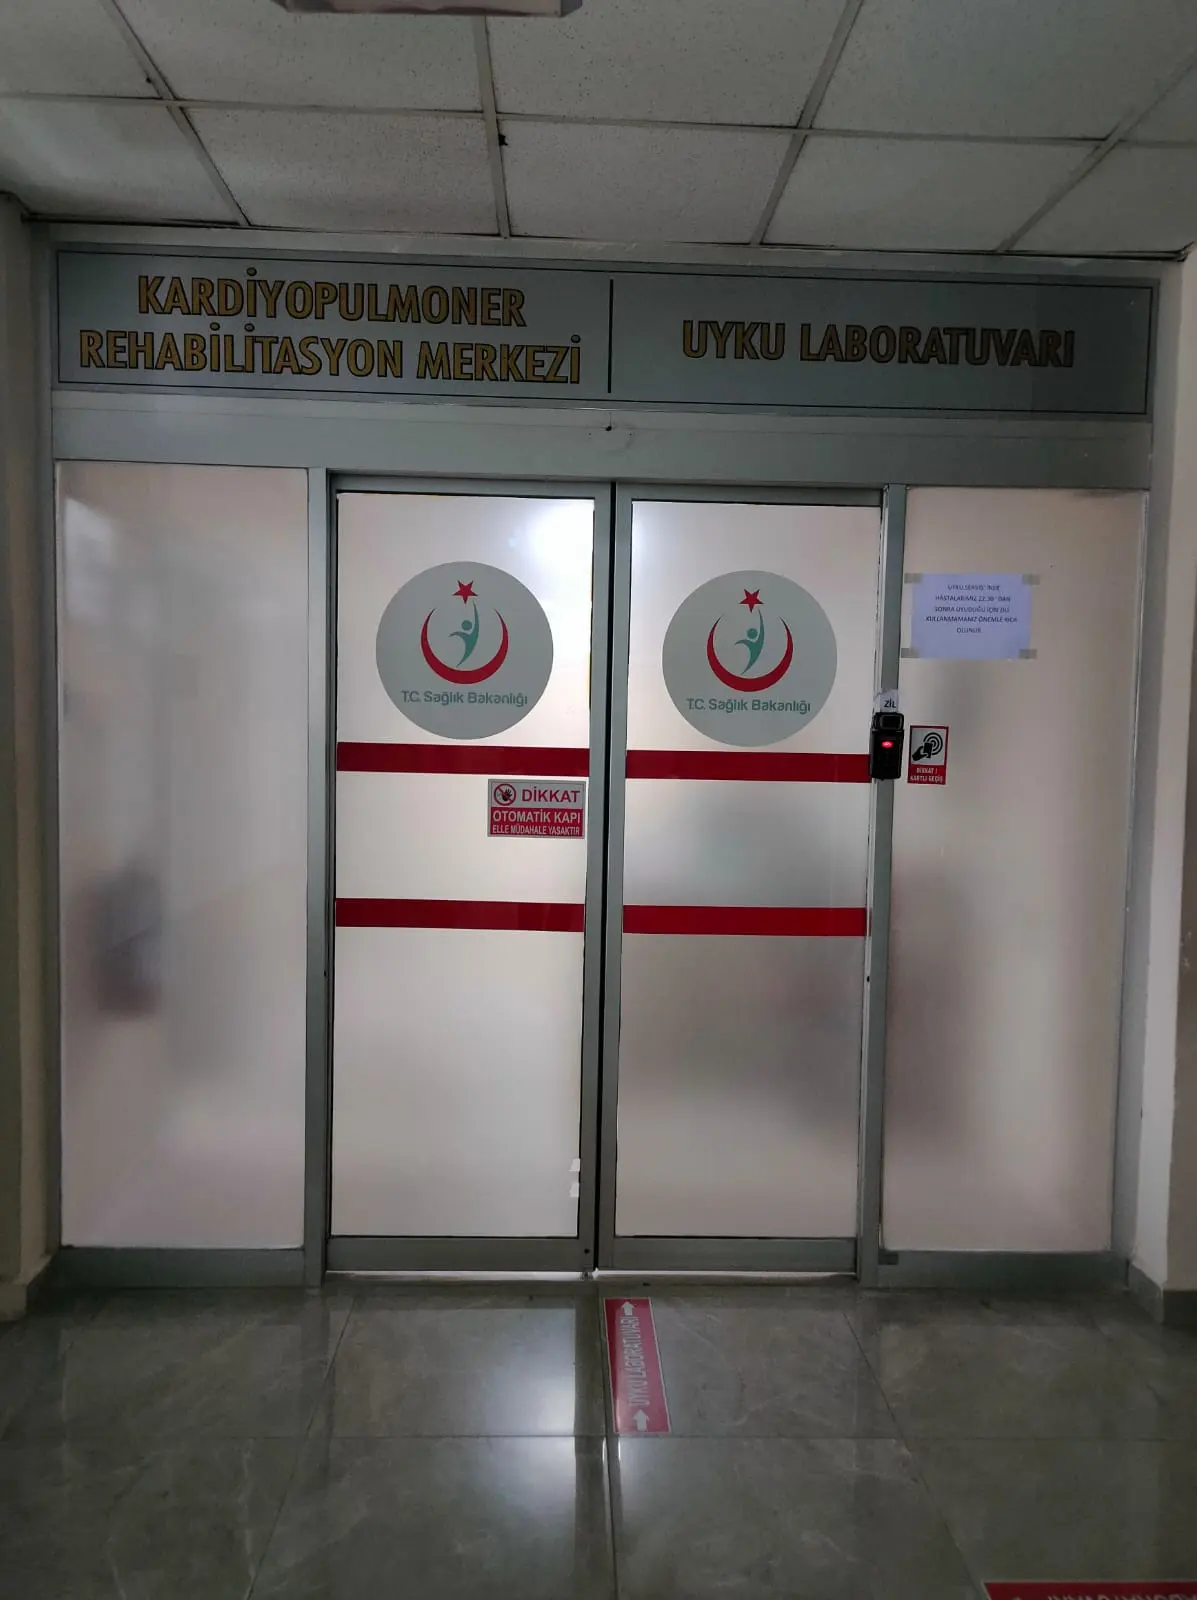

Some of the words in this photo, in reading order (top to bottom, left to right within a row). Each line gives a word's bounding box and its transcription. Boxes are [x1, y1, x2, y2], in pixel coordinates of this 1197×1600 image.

[138, 267, 526, 327] KARDİYOPULMONER
[682, 320, 786, 360] UYKU
[800, 323, 1075, 367] LABORATUVARI
[79, 322, 403, 378] REHABİLİTASYON
[416, 334, 581, 384] MERKEZİ
[423, 690, 465, 706] Sağlık
[467, 692, 528, 708] Bakanlığı
[708, 698, 749, 713] Sağlık
[751, 699, 811, 715] Bakanlığı
[522, 787, 580, 802] DİKKAT
[493, 809, 551, 822] OTOMATİK
[554, 812, 581, 824] KAPI
[492, 824, 509, 834] ELLE
[510, 824, 547, 835] MÜDAHALE
[548, 826, 580, 836] YASAKTIR
